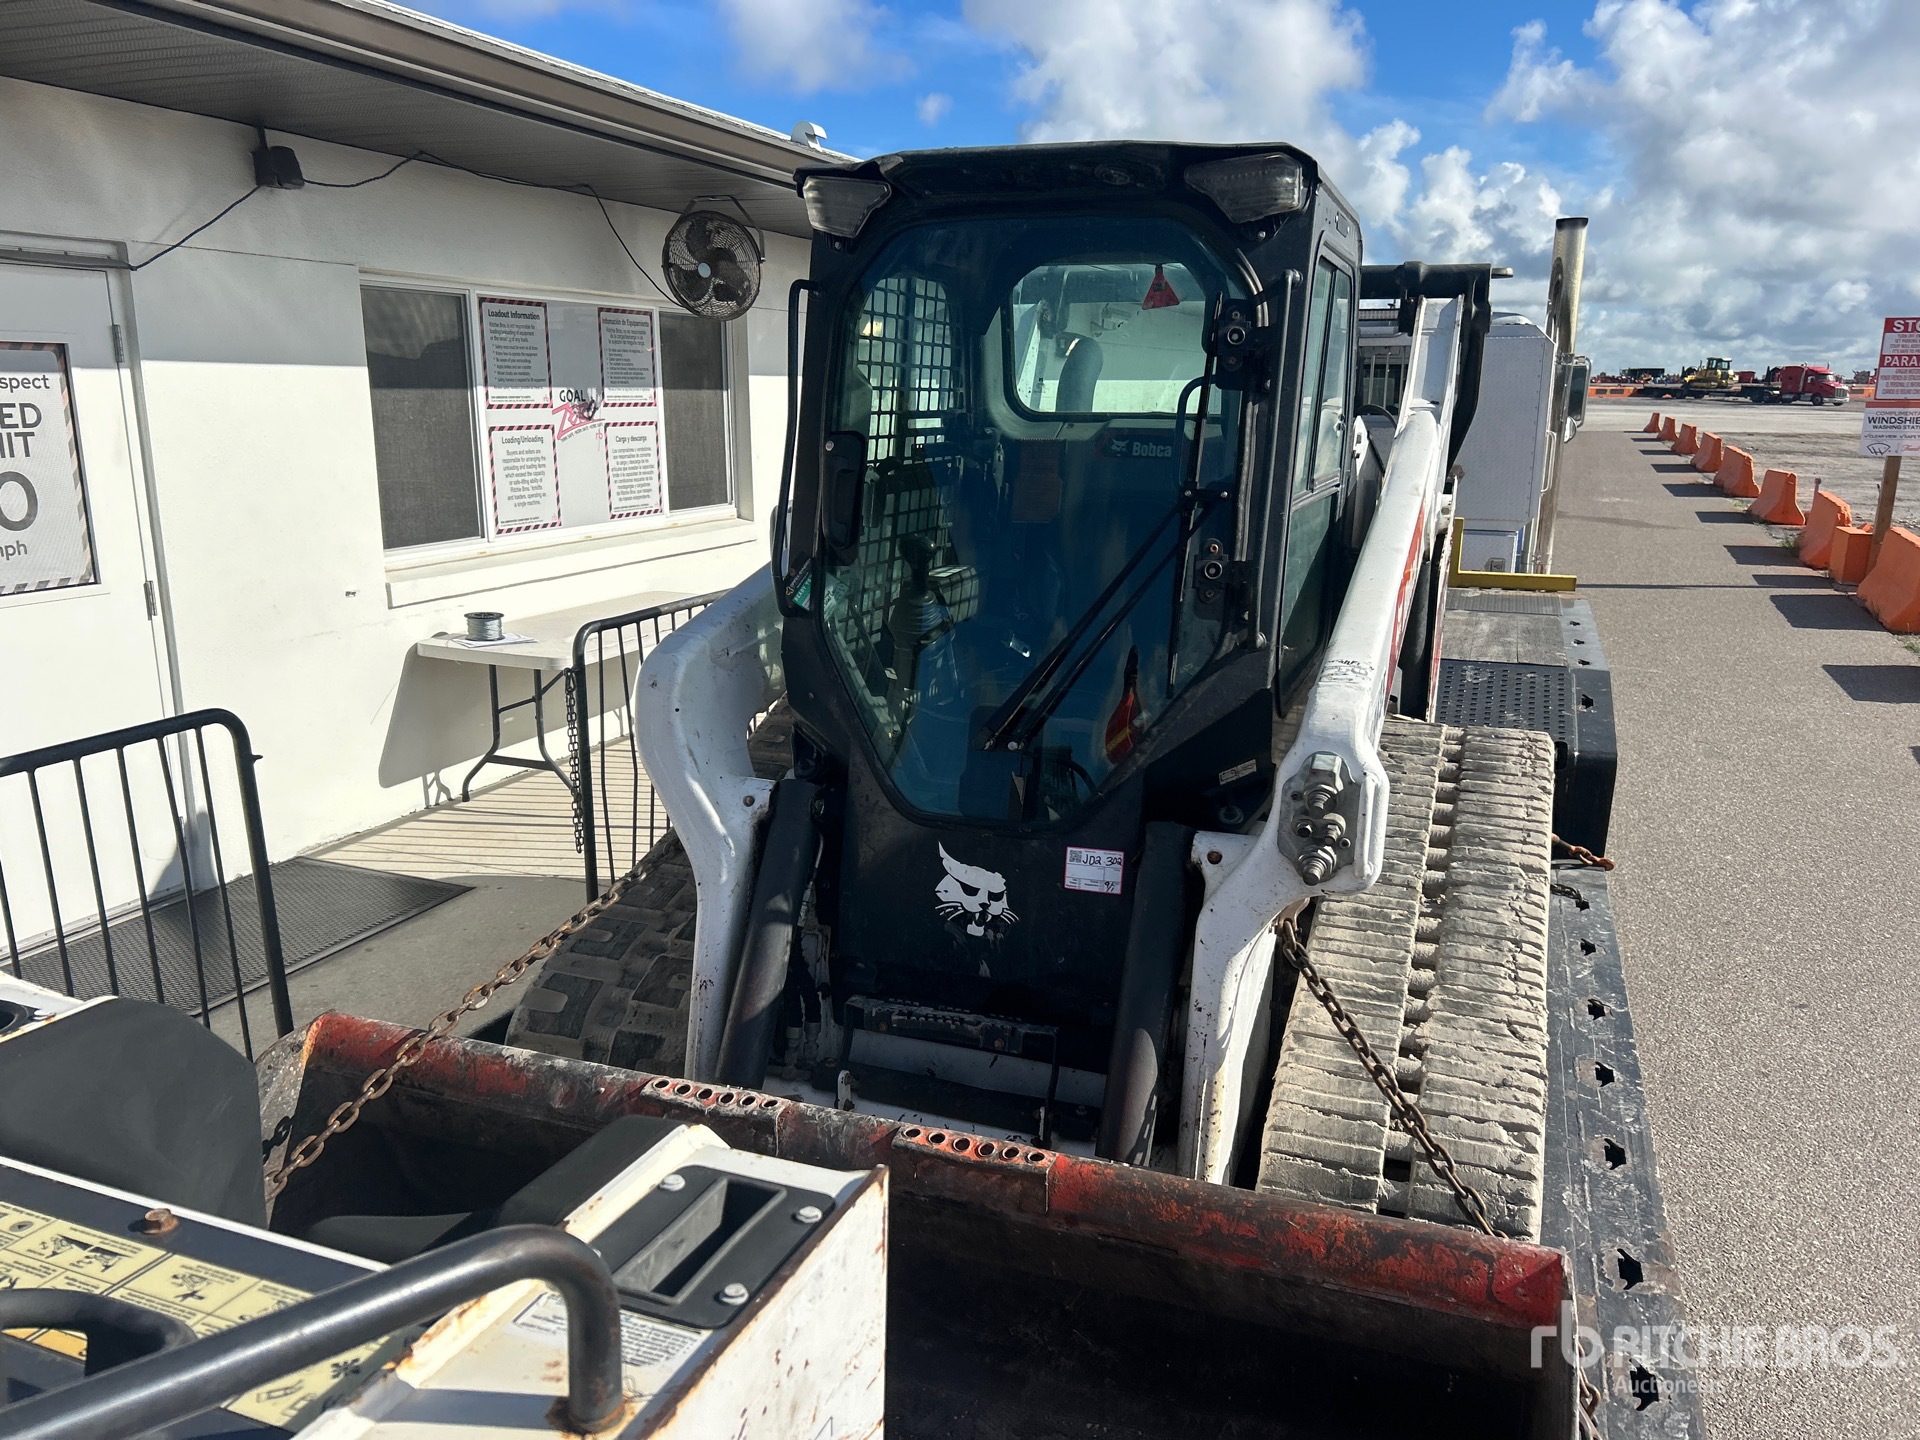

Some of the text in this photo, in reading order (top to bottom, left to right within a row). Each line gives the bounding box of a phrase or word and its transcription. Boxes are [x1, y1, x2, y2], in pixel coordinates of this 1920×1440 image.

[488, 309, 540, 320] Loadout Information
[1884, 356, 1920, 367] PARA
[0, 374, 50, 393] spect
[559, 389, 587, 402] GOAL
[501, 435, 544, 445] Loading/Unloading
[1132, 441, 1172, 457] Bobca
